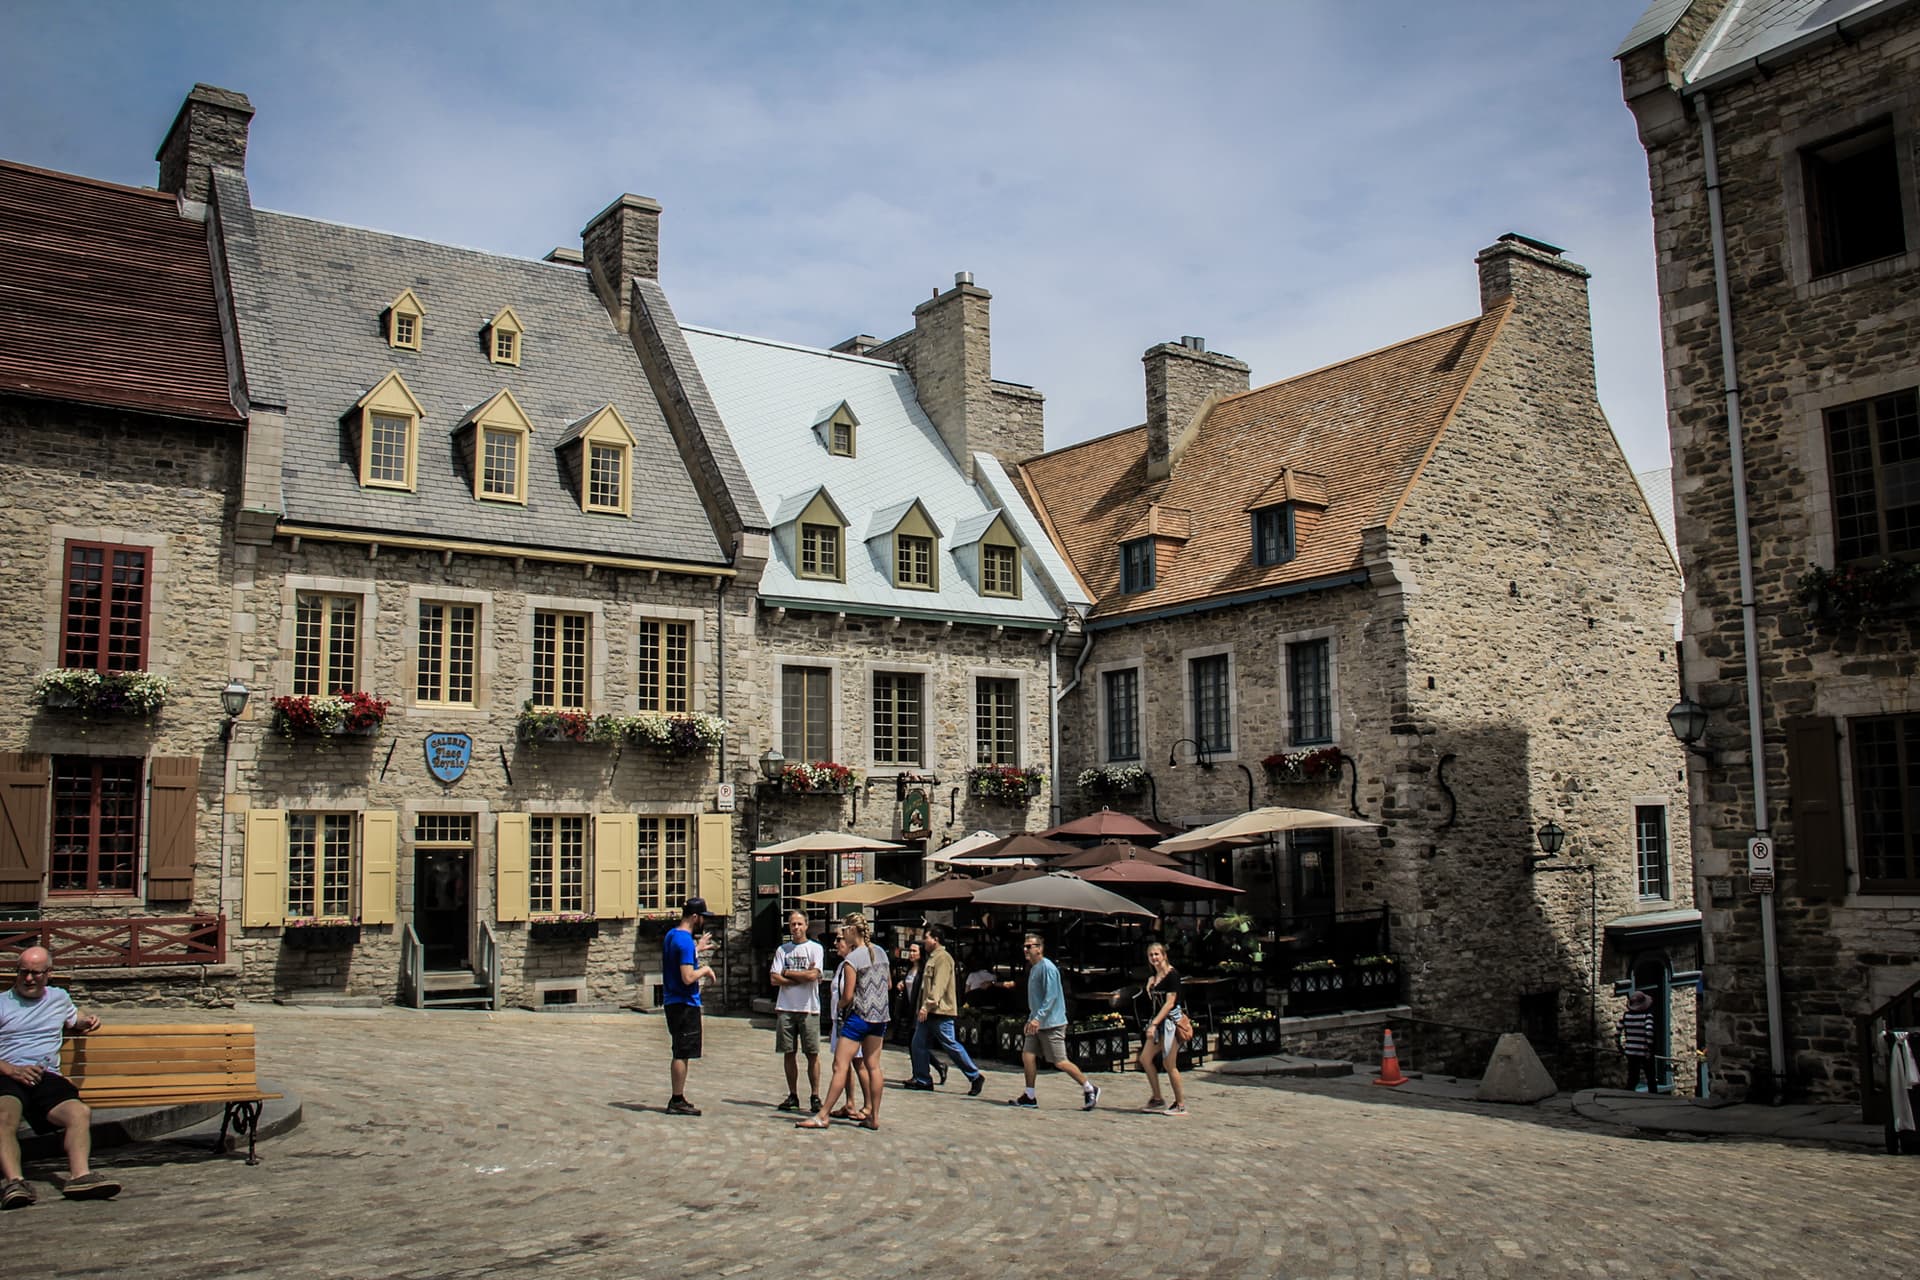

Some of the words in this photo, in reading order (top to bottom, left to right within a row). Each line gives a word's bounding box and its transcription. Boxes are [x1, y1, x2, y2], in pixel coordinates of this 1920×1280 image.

[431, 737, 466, 748] GALERIE
[435, 747, 462, 759] Place
[432, 756, 465, 770] Royale
